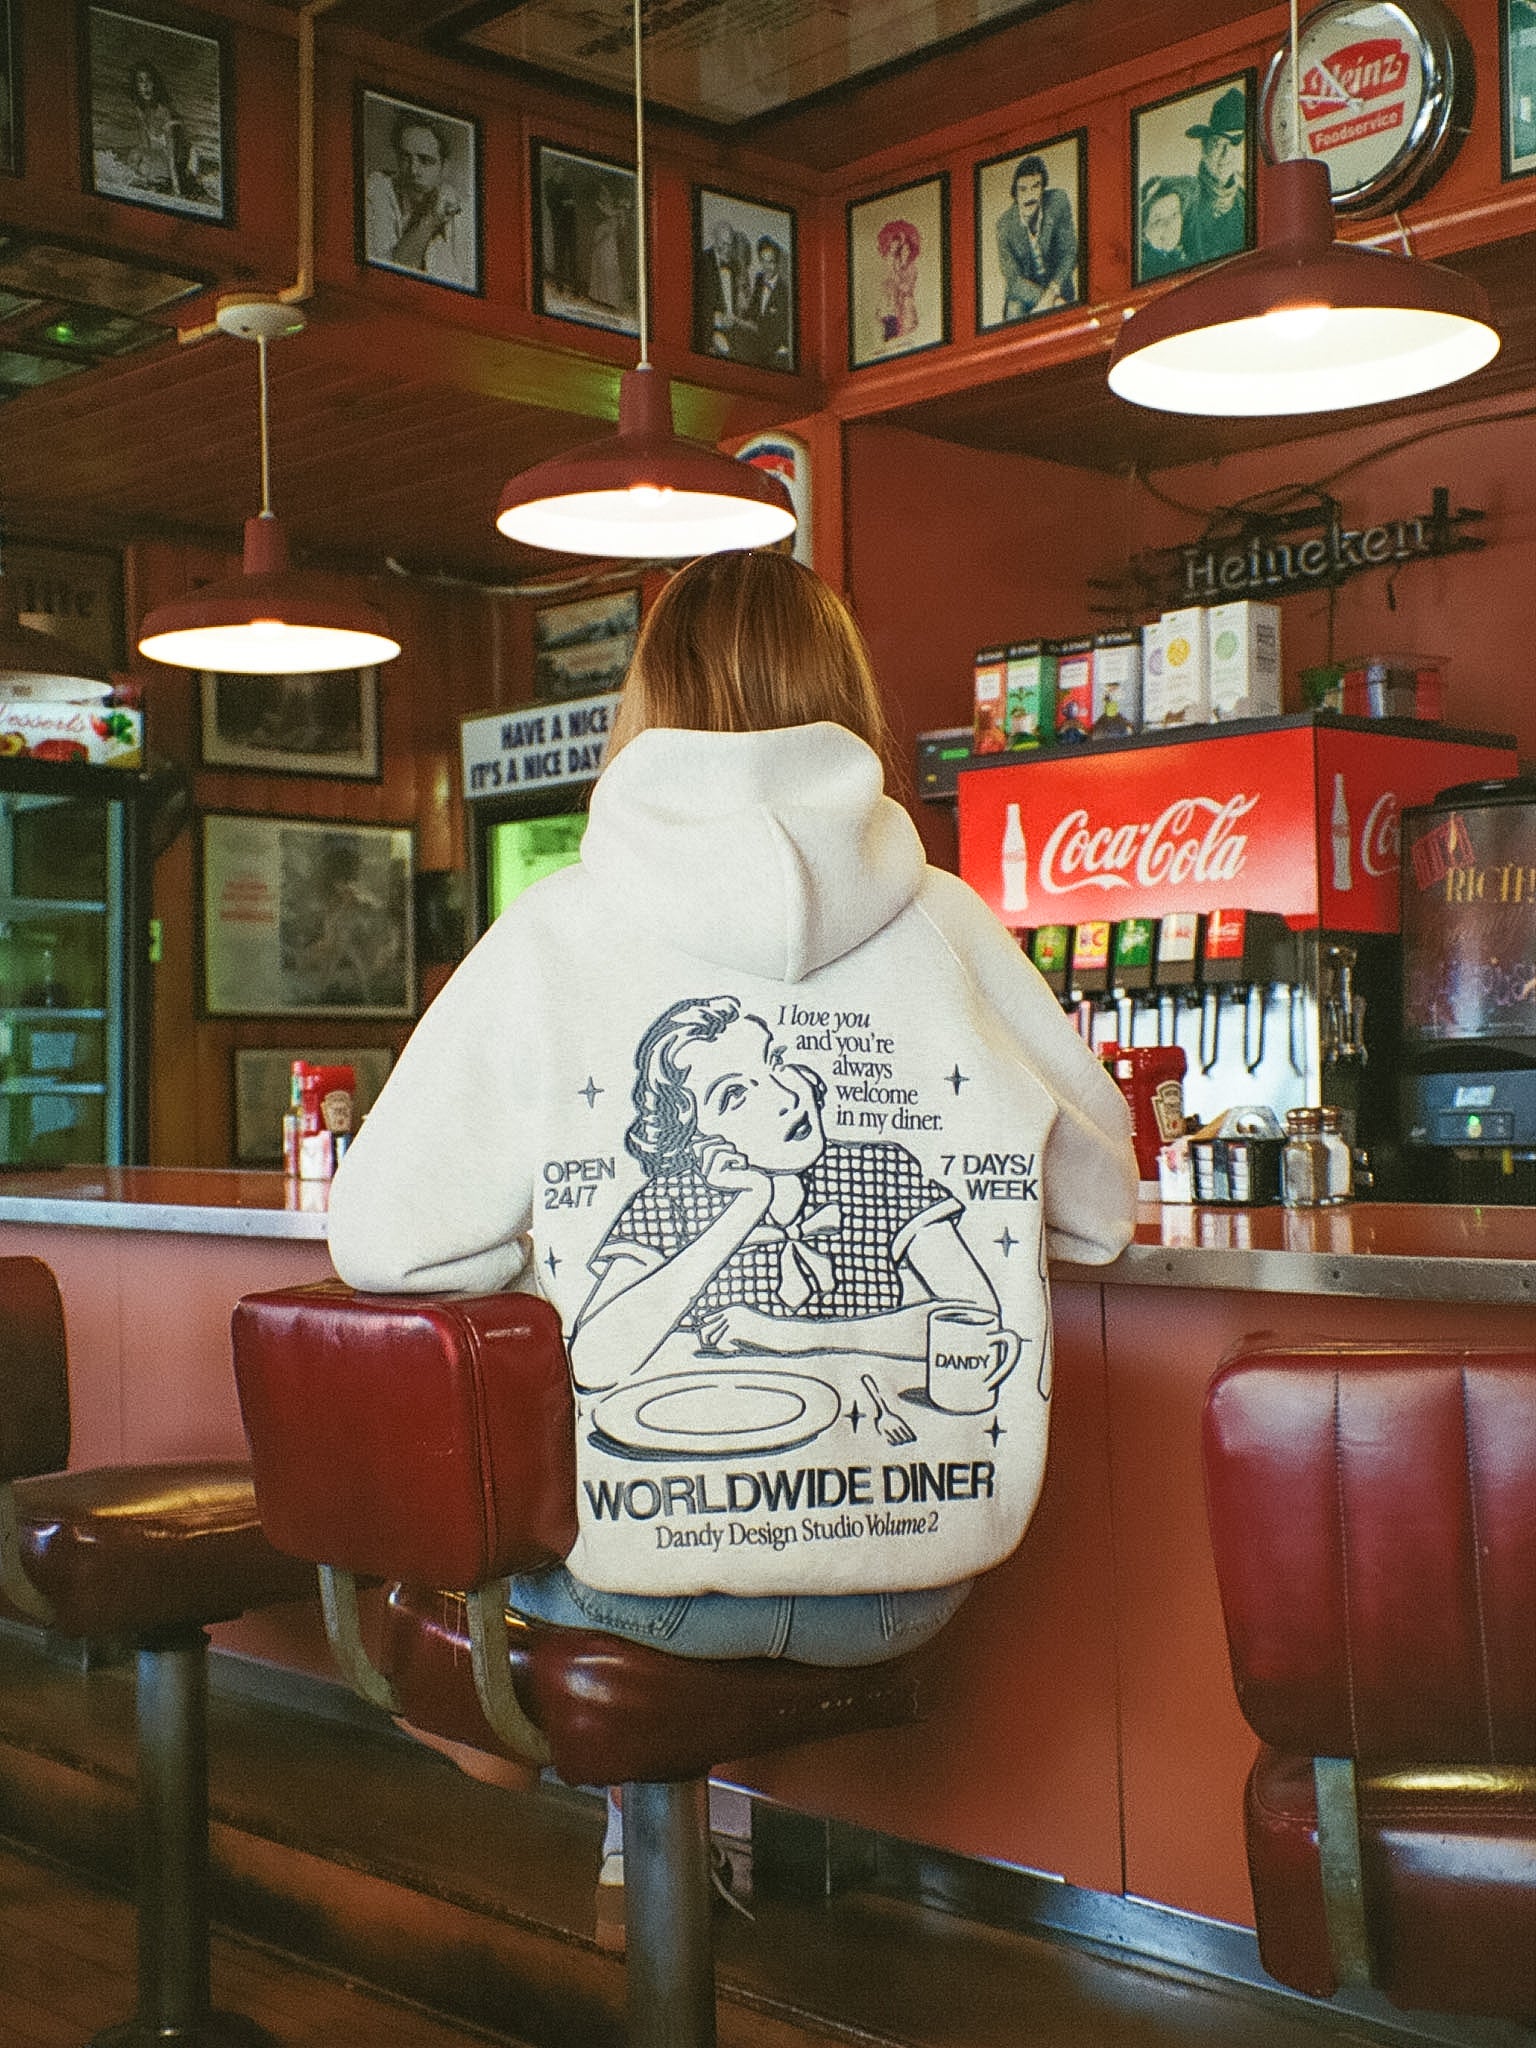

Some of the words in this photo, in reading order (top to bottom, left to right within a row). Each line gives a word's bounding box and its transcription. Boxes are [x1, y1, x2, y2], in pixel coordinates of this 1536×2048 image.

[1305, 54, 1403, 109] Heinz
[1315, 112, 1399, 149] Foodservice
[1183, 518, 1429, 596] Heineken
[502, 717, 545, 750] HAVE
[551, 714, 563, 741] A
[568, 706, 609, 738] NICE
[470, 760, 501, 789] IT'S
[506, 758, 518, 783] A
[523, 750, 561, 780] NICE
[568, 742, 604, 774] DAY
[1039, 793, 1260, 894] Coca-Cola
[777, 1005, 786, 1025] I
[791, 1004, 830, 1026] love
[832, 1012, 871, 1033] you
[796, 1029, 832, 1051] and
[835, 1033, 895, 1057] you're
[832, 1054, 893, 1084] always
[836, 1081, 918, 1105] welcome
[836, 1105, 855, 1126] in
[859, 1111, 888, 1135] my
[891, 1107, 943, 1131] diner.
[544, 1157, 615, 1184] OPEN
[941, 1155, 955, 1176] 7
[963, 1154, 1034, 1176] DAYS/
[544, 1184, 598, 1210] 24/7
[966, 1178, 1038, 1201] WEEK
[934, 1353, 989, 1370] DANDY
[583, 1465, 872, 1520] WORLDWIDE
[883, 1460, 995, 1503] DINER
[655, 1522, 725, 1552] Dandy
[728, 1522, 798, 1551] Design
[802, 1514, 864, 1542] Studio
[864, 1511, 926, 1538] Volume
[927, 1511, 939, 1533] 2
